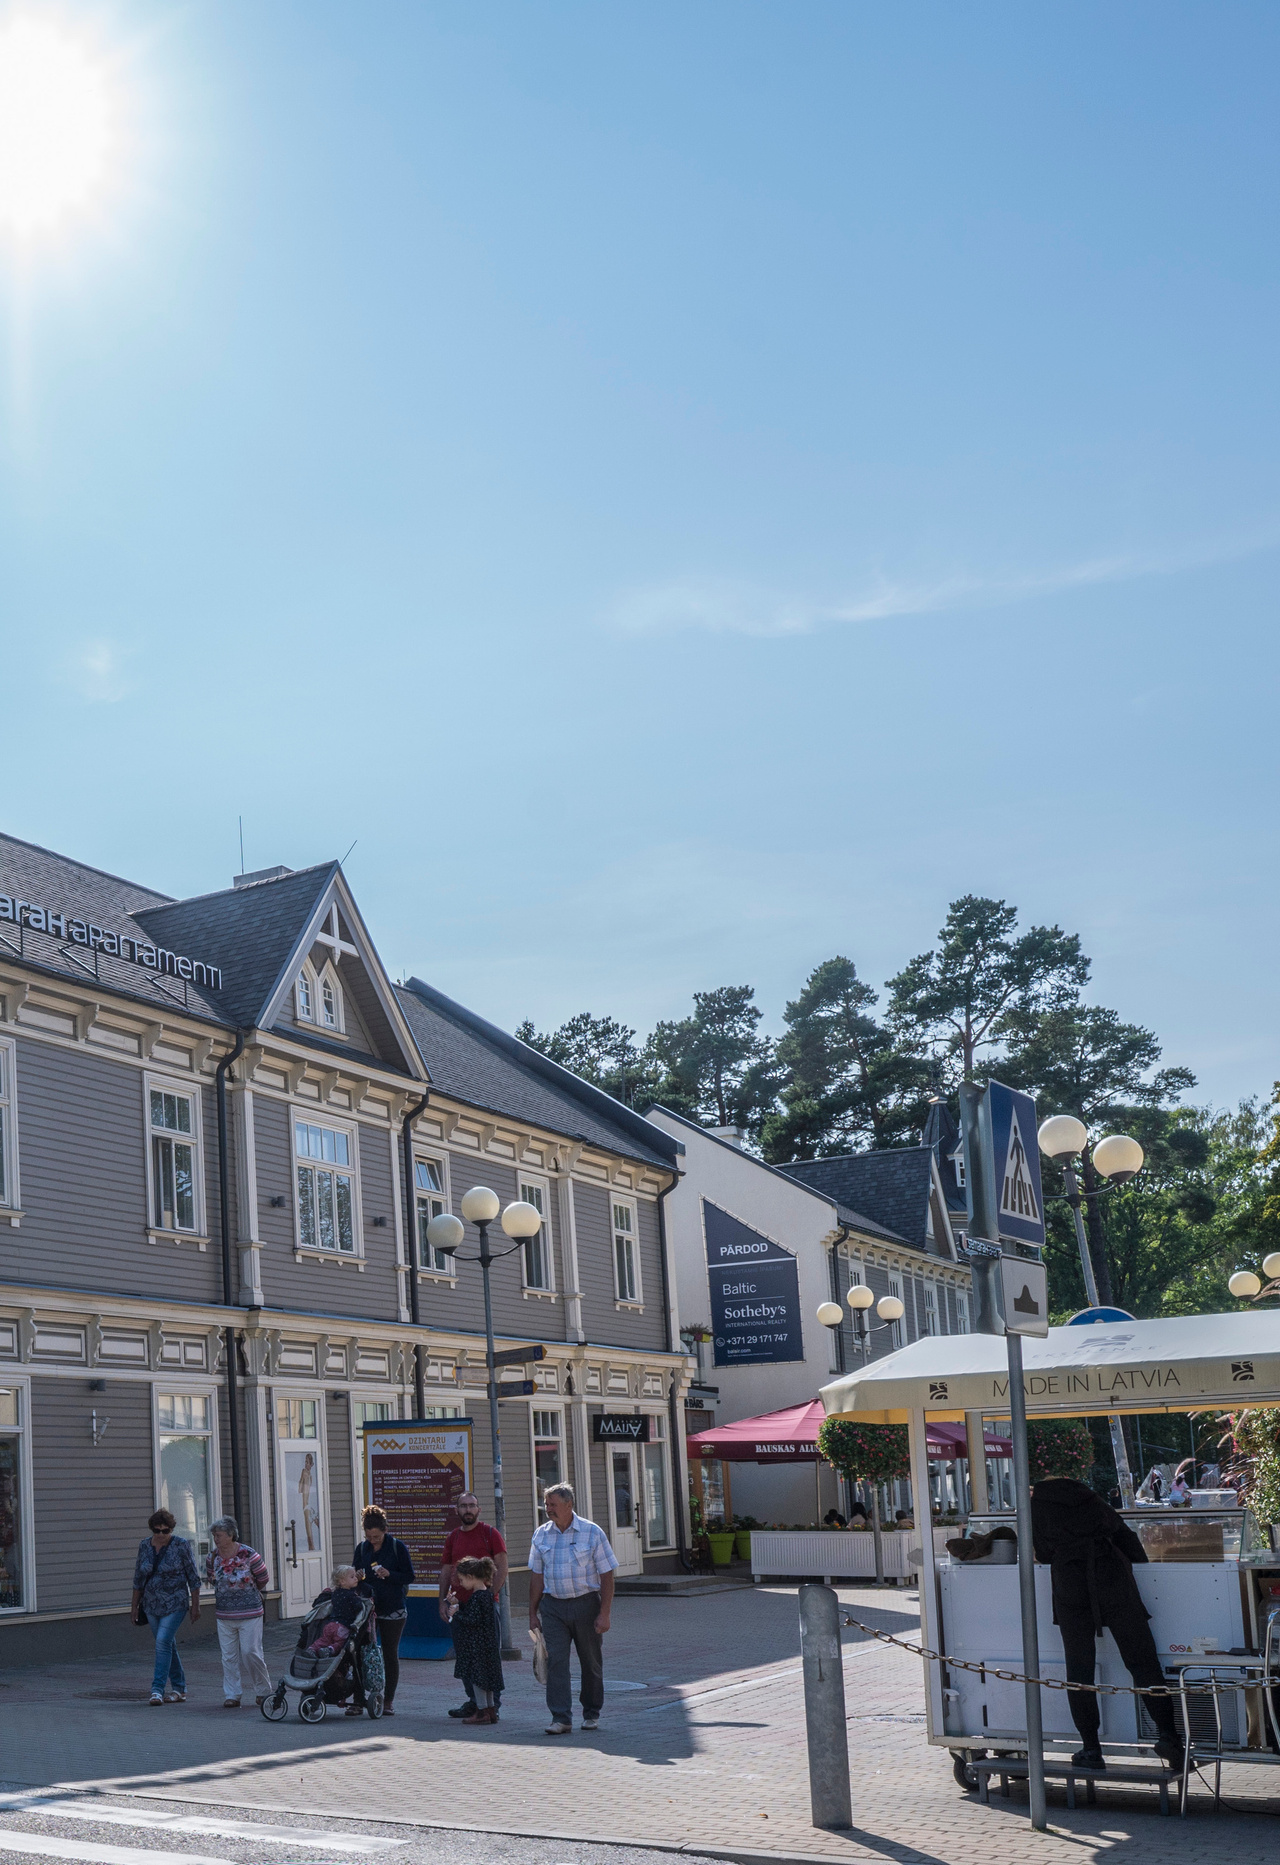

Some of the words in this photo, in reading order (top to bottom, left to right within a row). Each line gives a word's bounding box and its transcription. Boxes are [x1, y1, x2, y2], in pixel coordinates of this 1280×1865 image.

[720, 1243, 768, 1256] PĀRDOD
[723, 1282, 756, 1295] Baltic
[725, 1304, 786, 1319] Sotheby's
[727, 1337, 745, 1345] +371
[759, 1335, 772, 1343] 171
[1067, 1374, 1089, 1392] IN
[1098, 1368, 1180, 1391] LATVIA
[408, 1436, 446, 1445] DZINTARU
[755, 1444, 795, 1453] BAUSKAS
